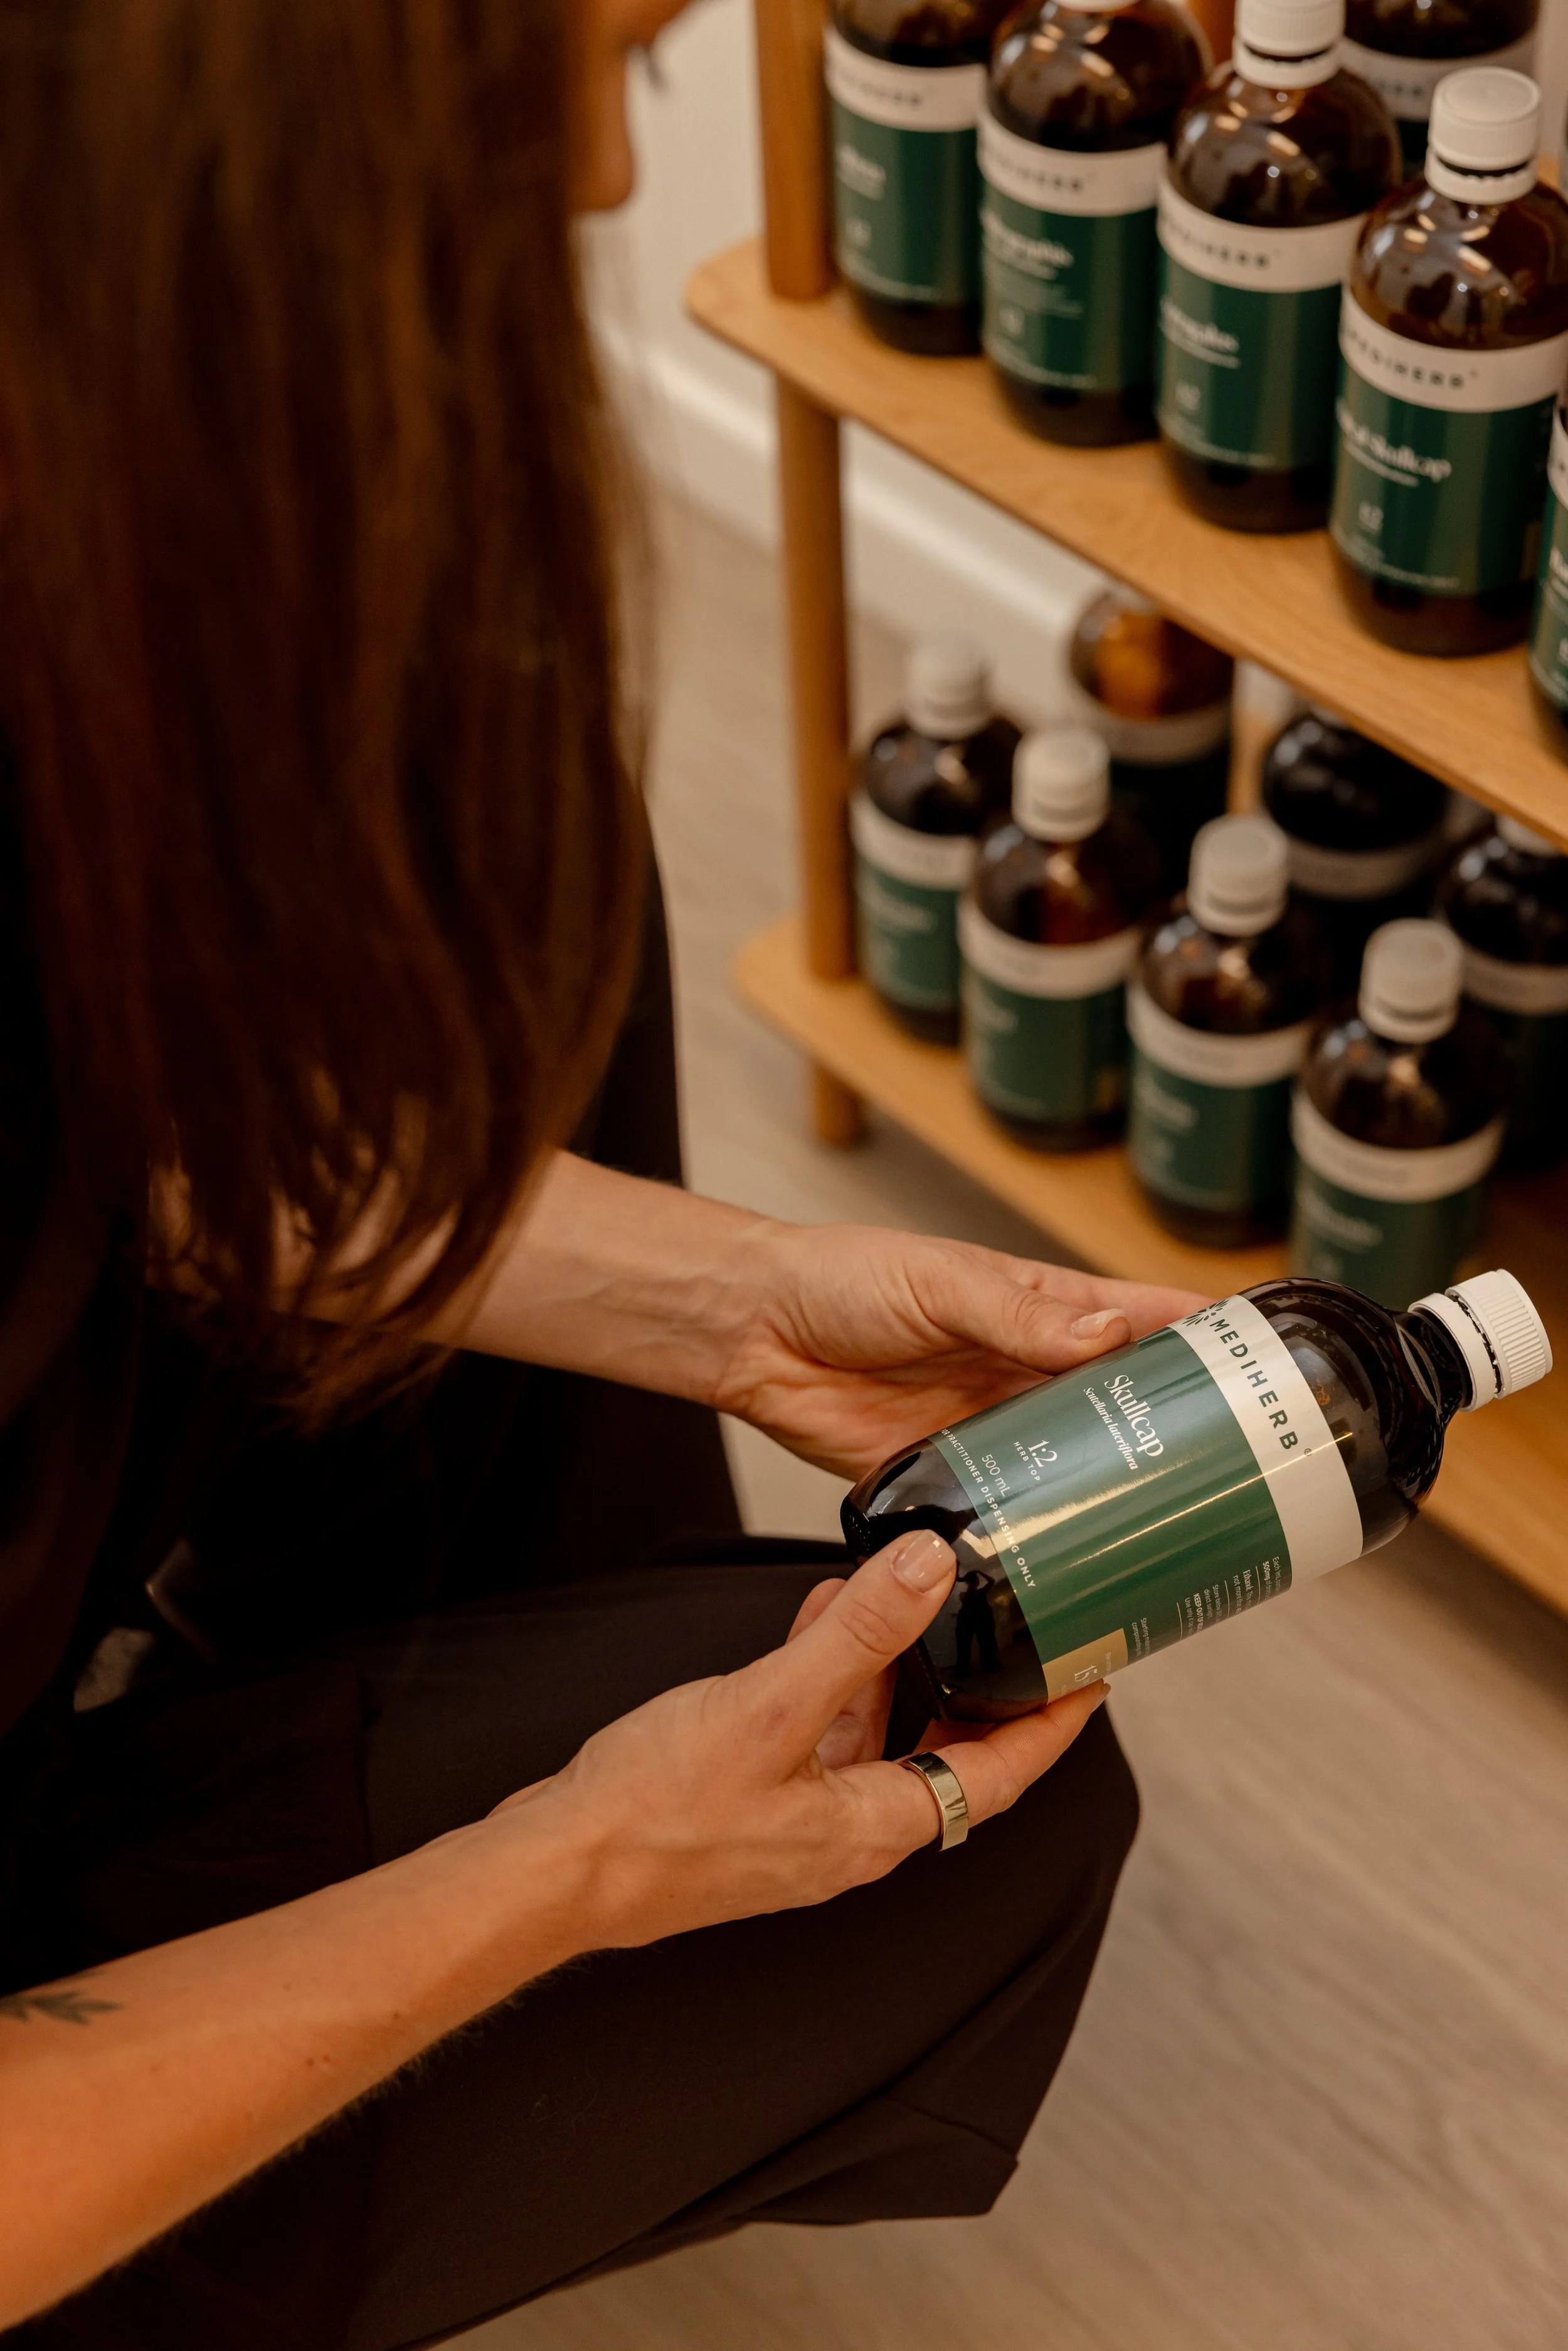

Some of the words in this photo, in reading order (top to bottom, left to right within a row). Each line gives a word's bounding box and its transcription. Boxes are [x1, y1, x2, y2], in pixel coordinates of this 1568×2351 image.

[1083, 1387, 1113, 1424] Scutellaria
[1107, 1423, 1138, 1470] lateriflora
[1104, 1375, 1164, 1457] Skullcap
[1014, 1441, 1029, 1462] HERB
[1027, 1464, 1041, 1481] TOP
[1028, 1440, 1058, 1468] 1:2
[982, 1454, 1001, 1476] 500
[995, 1477, 1010, 1497] mL
[948, 1434, 984, 1484] PRACTITIONER
[981, 1485, 1020, 1553] DISPENSING
[1017, 1557, 1036, 1588] ONLY
[1263, 1561, 1271, 1581] 500mg
[1272, 1556, 1281, 1571] Each
[1193, 1593, 1202, 1607] KEEP
[1204, 1588, 1212, 1604] direct
[1140, 1617, 1149, 1637] Starting
